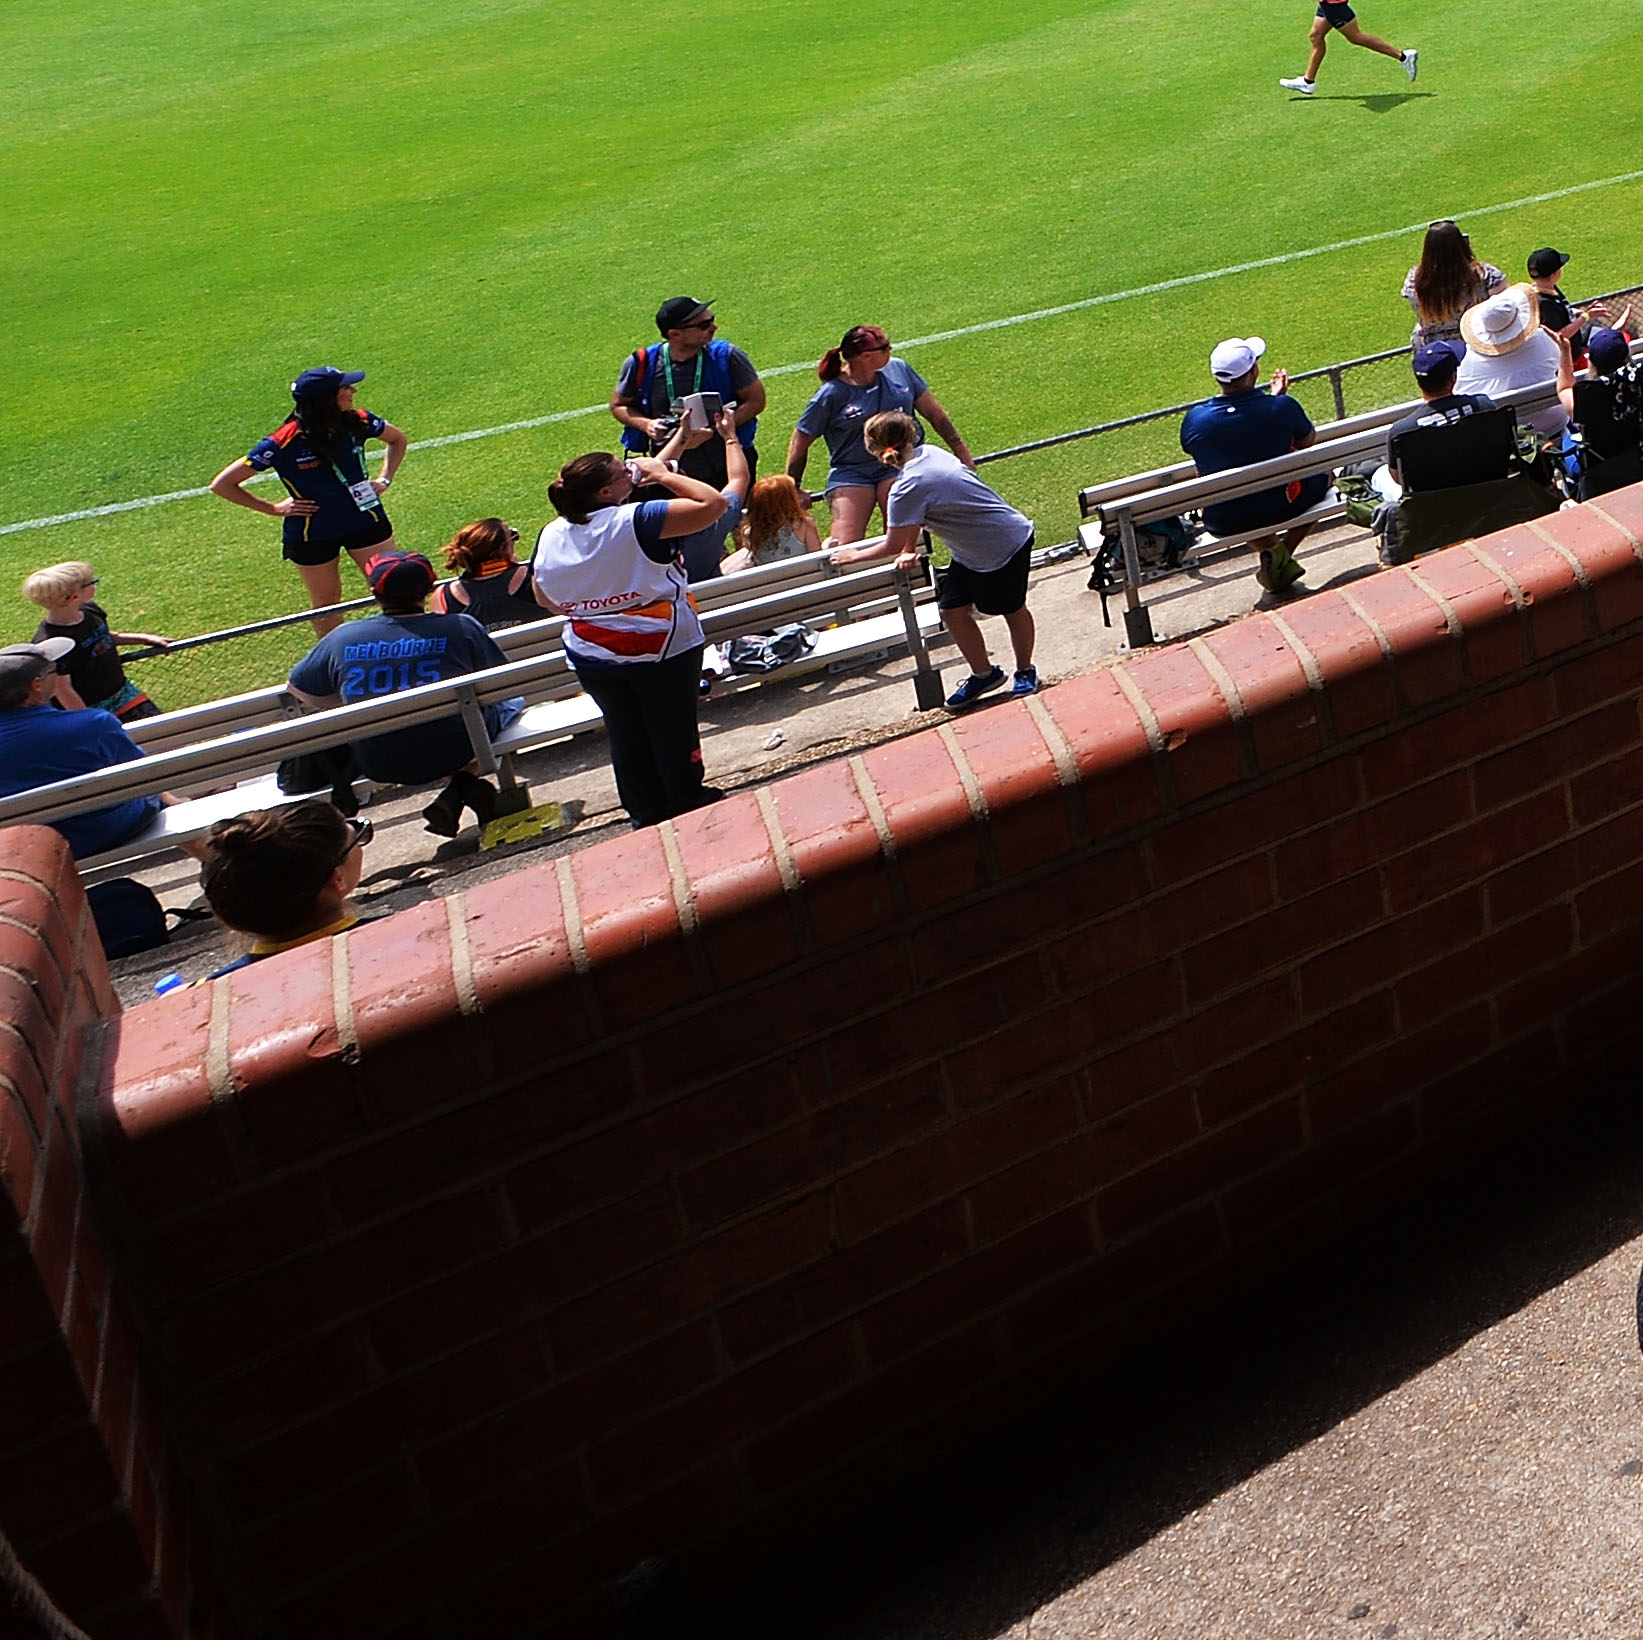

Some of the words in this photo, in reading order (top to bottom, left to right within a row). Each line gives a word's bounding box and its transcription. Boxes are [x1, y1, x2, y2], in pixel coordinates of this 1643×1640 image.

[581, 591, 643, 611] TOYOTA
[344, 637, 447, 661] MELBOURNE
[344, 659, 441, 696] 2015
